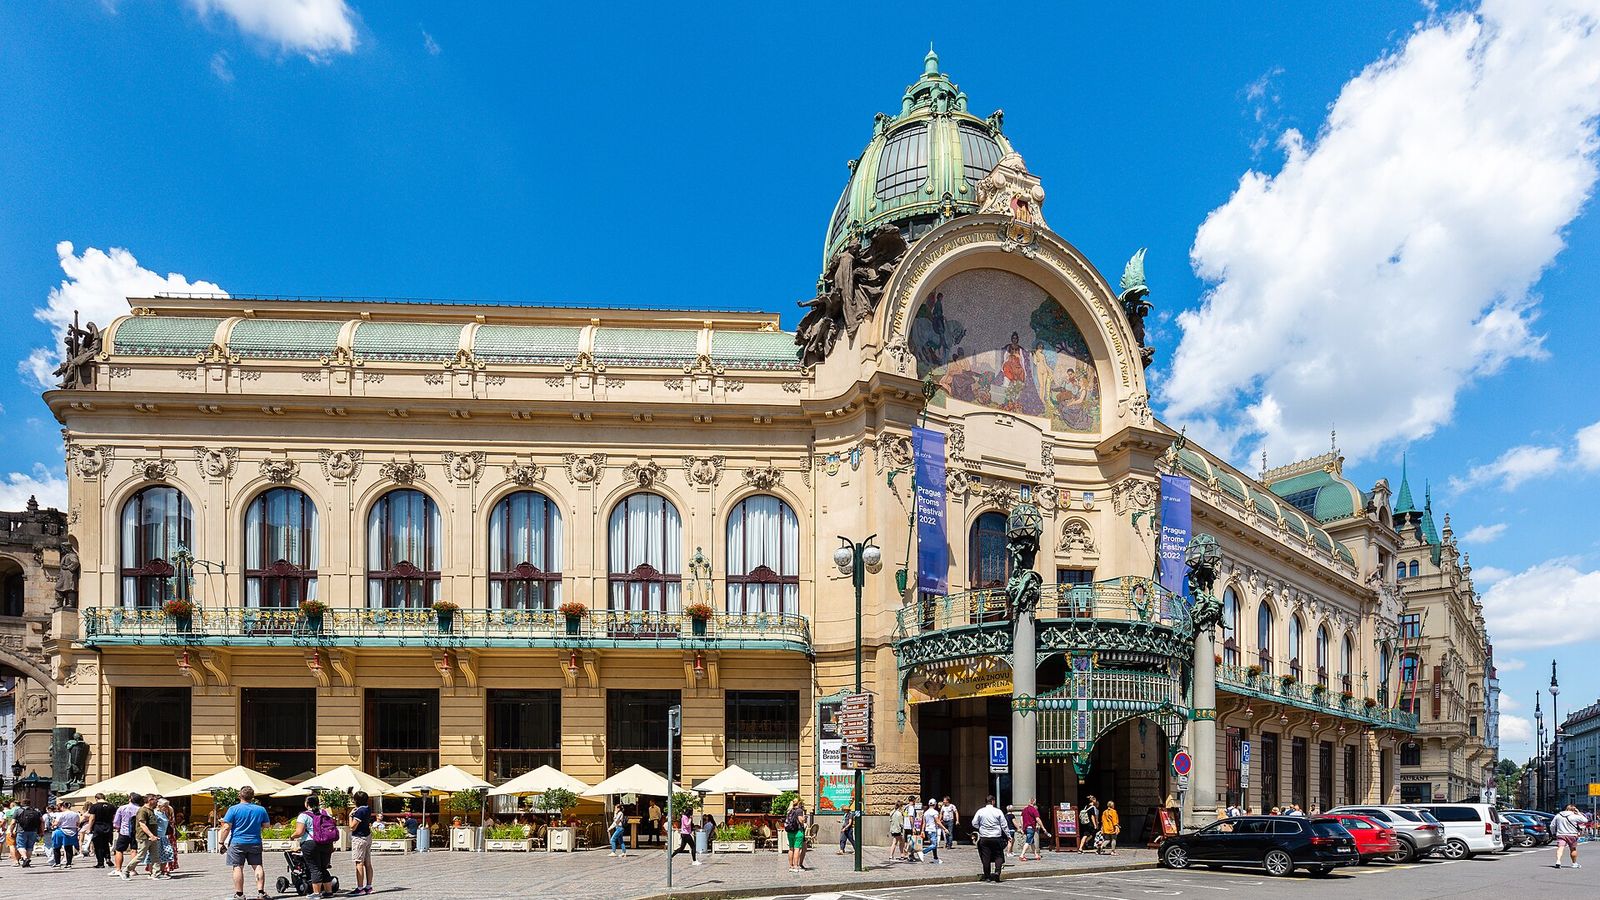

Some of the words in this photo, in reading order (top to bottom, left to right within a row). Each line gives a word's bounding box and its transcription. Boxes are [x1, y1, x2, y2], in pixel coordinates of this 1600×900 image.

[917, 485, 941, 498] Prague
[918, 495, 940, 507] Proms
[919, 505, 943, 517] Festival
[919, 515, 936, 525] 2022
[1162, 526, 1186, 535] Prague
[1162, 534, 1185, 543] Proms
[987, 672, 1010, 680] ZNOVU
[994, 740, 1004, 757] P
